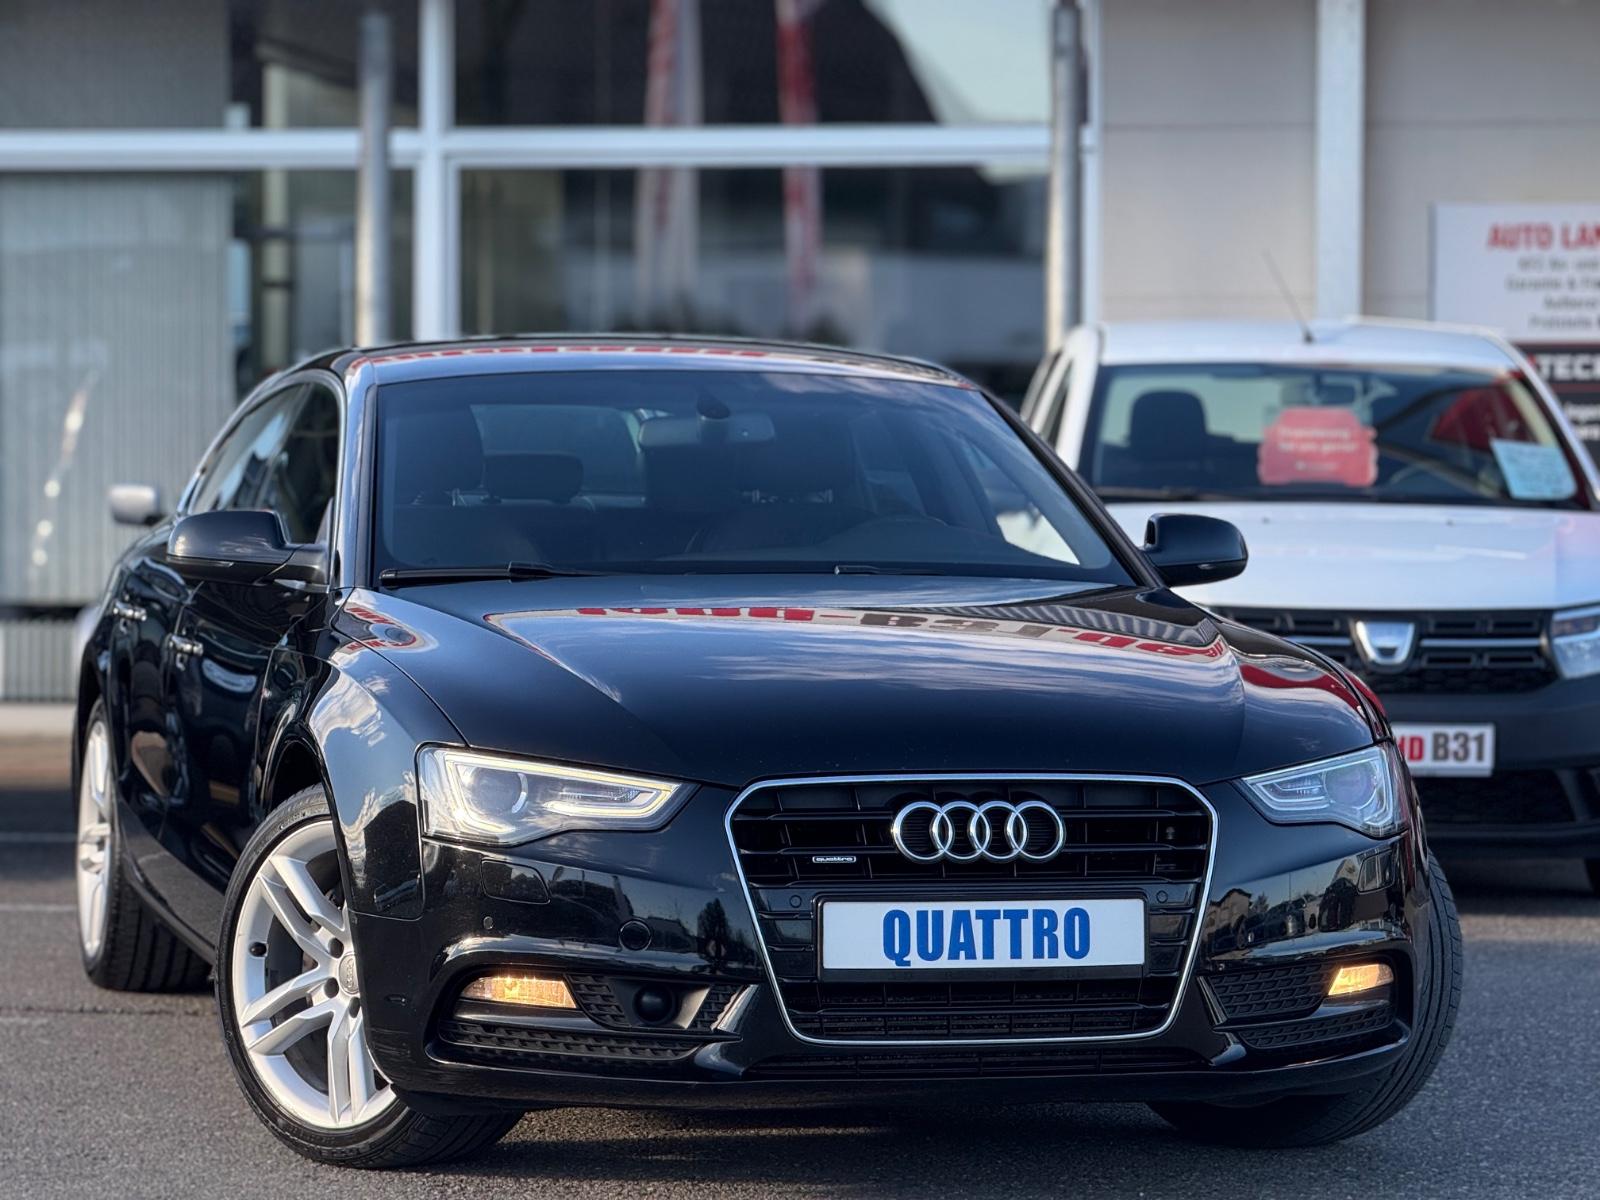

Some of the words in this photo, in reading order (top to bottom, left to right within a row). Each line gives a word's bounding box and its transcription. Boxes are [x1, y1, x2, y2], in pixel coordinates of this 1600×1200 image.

[1487, 223, 1553, 250] AUTO
[1536, 354, 1600, 381] TEC
[1432, 731, 1485, 762] B31
[883, 906, 1091, 967] QUATTRO
